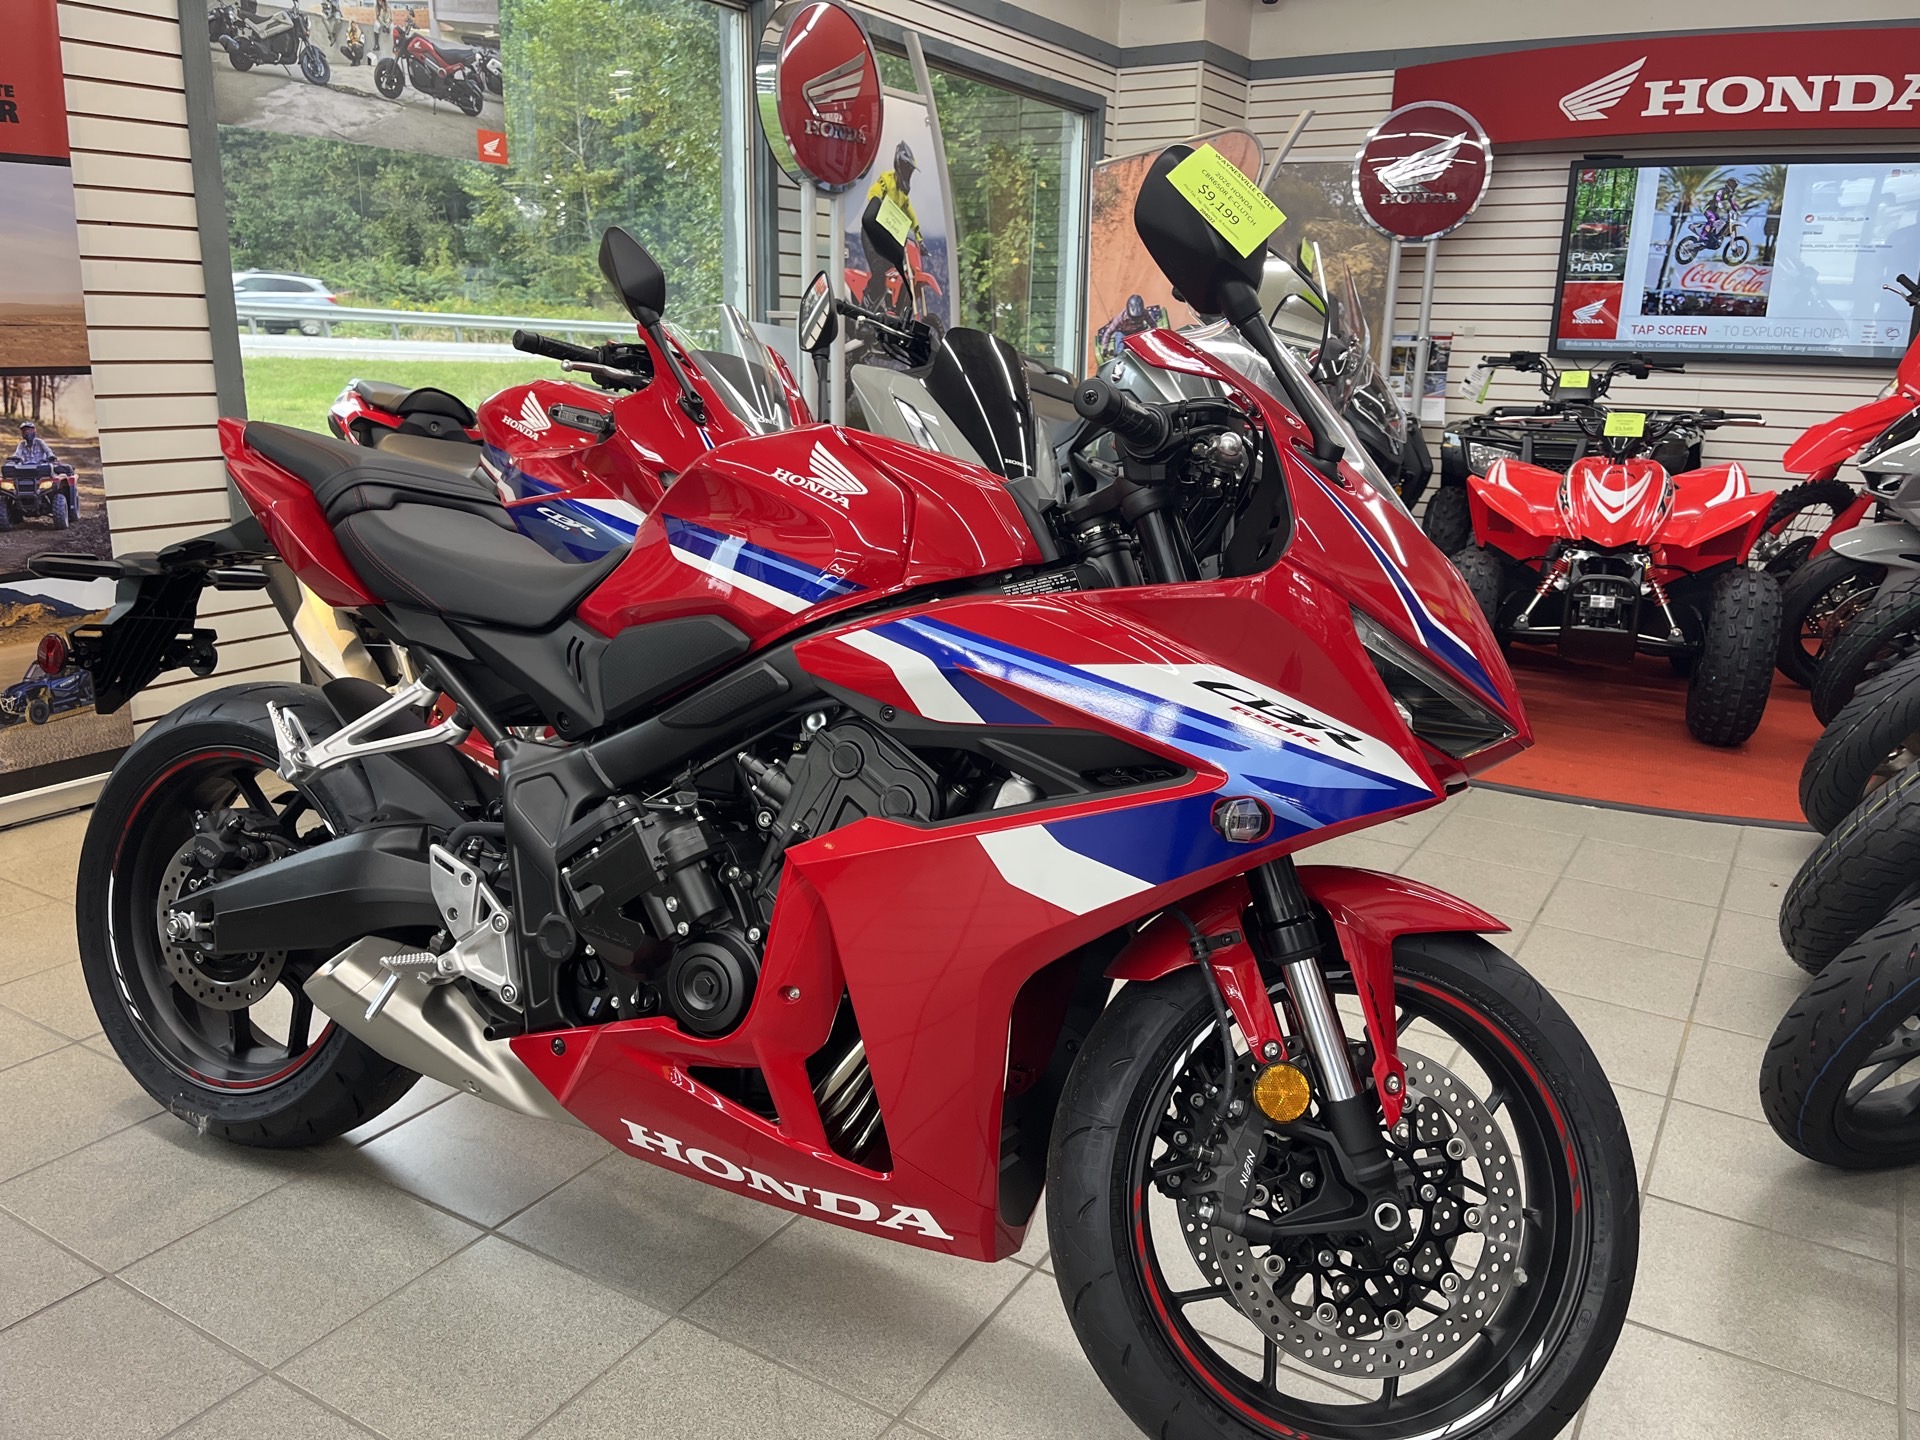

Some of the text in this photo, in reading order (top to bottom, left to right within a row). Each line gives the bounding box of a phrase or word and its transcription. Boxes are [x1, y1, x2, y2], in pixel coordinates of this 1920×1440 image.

[805, 120, 866, 144] HONDA
[1200, 168, 1229, 196] CBR650R
[1226, 195, 1257, 226] E-CLUTCH
[1214, 171, 1231, 187] 2026
[1229, 186, 1254, 211] HONDA
[1215, 153, 1257, 193] WAYNESVILLE
[1256, 191, 1276, 211] CYCLE
[1379, 192, 1460, 205] HONDA
[1197, 184, 1240, 225] $9,199
[1570, 263, 1614, 272] HARD
[1572, 252, 1608, 261] PLAY
[1681, 263, 1771, 293] Coca-Cola
[1631, 324, 1708, 336] TAP SCREEN
[1637, 341, 1654, 349] Cycle
[1723, 325, 1850, 339] TO EXPLORE HONDA
[502, 415, 539, 442] HONDA
[771, 467, 850, 510] HONDA
[536, 507, 597, 540] CBR
[1192, 680, 1366, 757] CBR
[1229, 705, 1322, 747] 650R
[620, 1117, 954, 1241] HONDA
[1239, 1148, 1256, 1189] NISSIN
